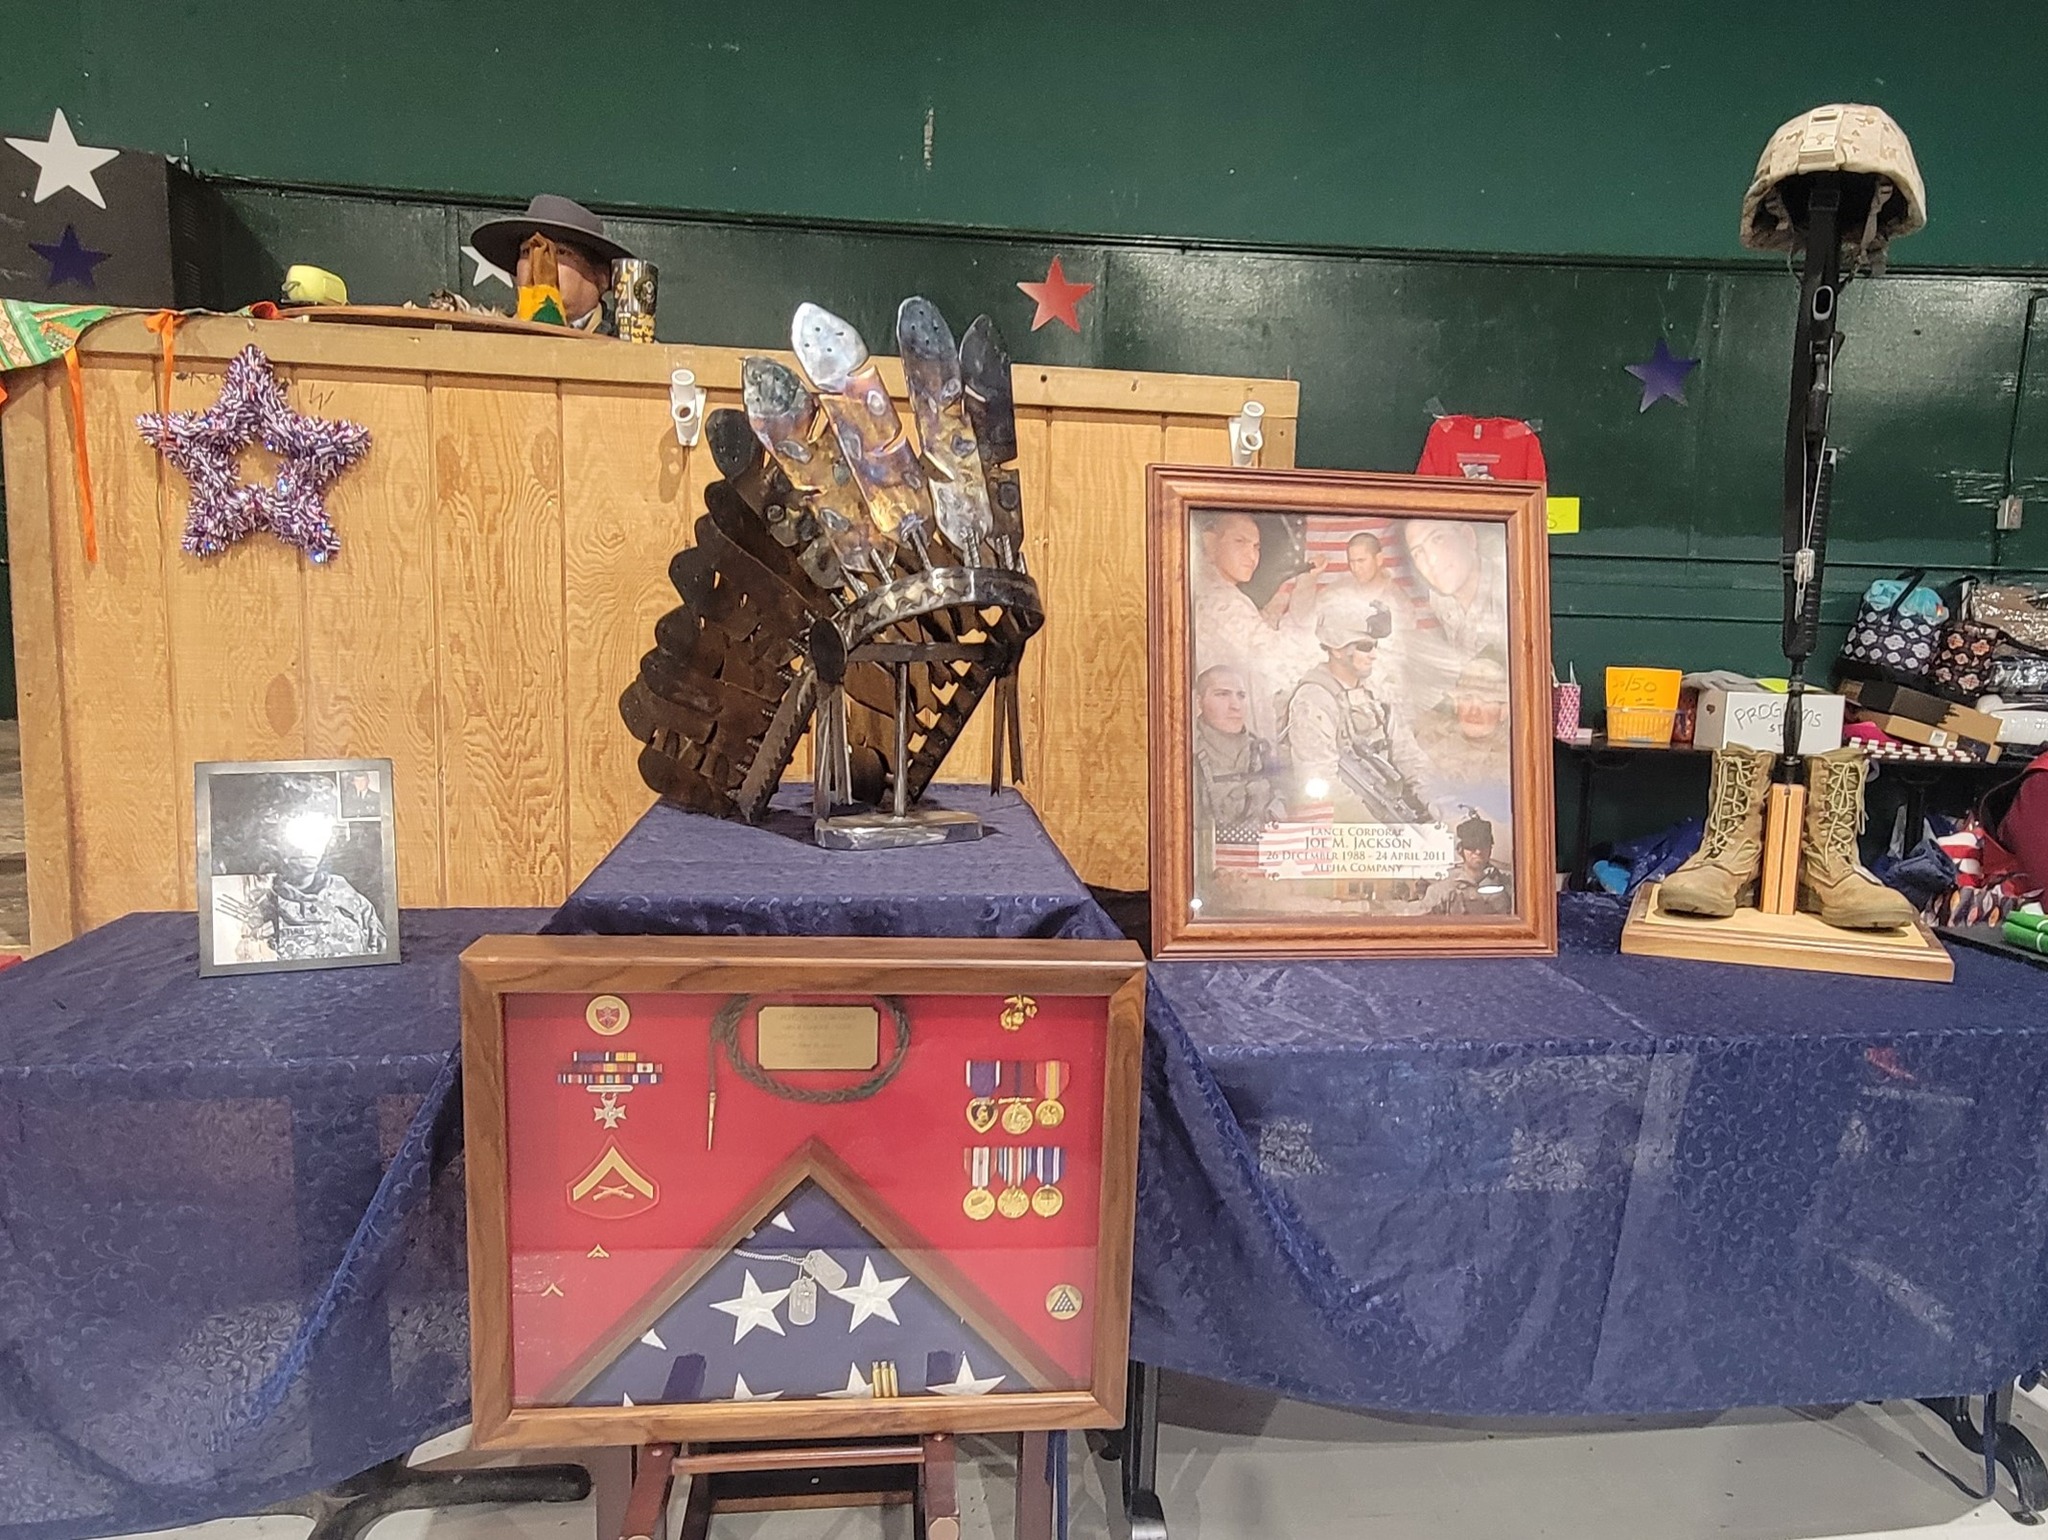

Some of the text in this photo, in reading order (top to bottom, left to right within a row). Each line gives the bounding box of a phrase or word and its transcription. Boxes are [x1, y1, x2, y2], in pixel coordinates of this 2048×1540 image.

[1734, 701, 1822, 730] PROGMS
[1311, 826, 1405, 837] LANCE CORPORAL
[1305, 836, 1412, 850] JOE M. JACKSON
[1266, 850, 1279, 860] 26
[1282, 850, 1339, 861] DECEMBER
[1342, 850, 1366, 861] 1988
[1375, 850, 1388, 861] 24
[1390, 850, 1420, 861] APRIL
[1422, 850, 1446, 861] 2011
[1312, 862, 1402, 873] ALPHA COMPANY
